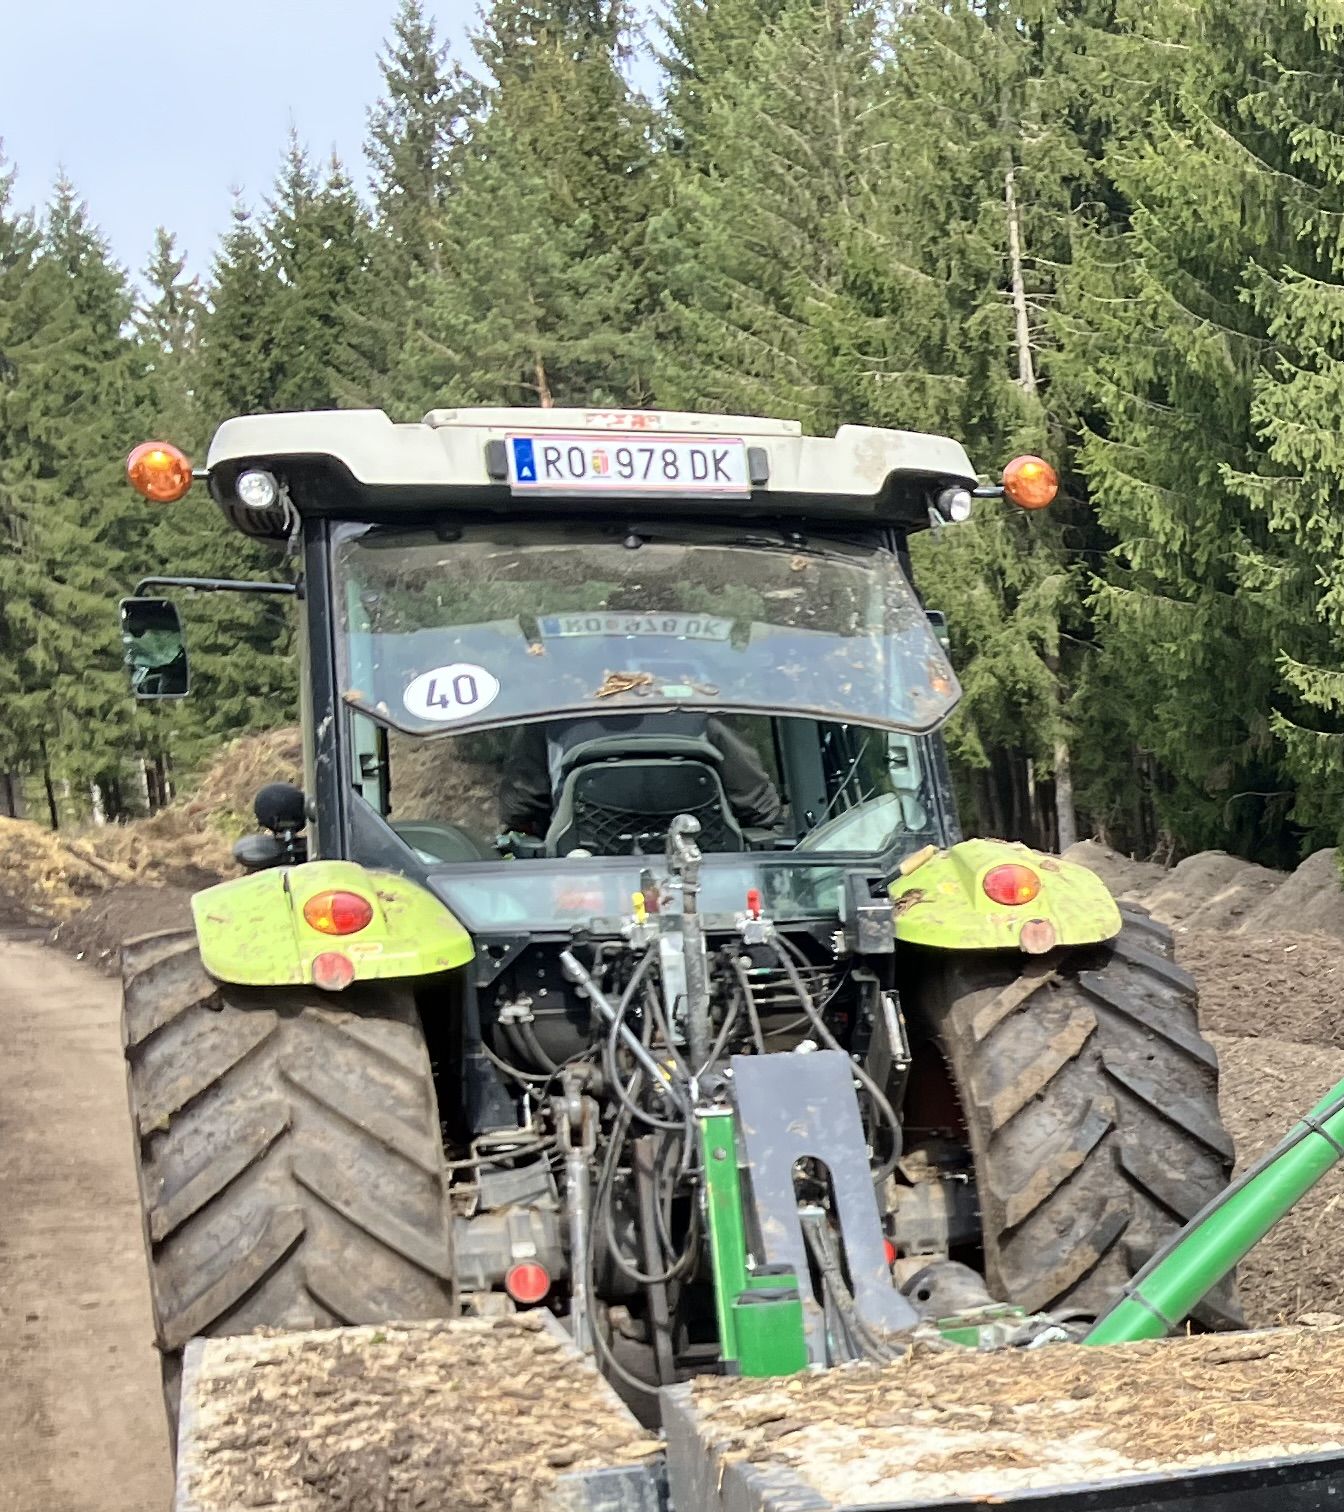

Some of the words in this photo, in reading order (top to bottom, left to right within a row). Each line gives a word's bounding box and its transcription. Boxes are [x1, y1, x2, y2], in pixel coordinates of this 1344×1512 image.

[543, 446, 587, 478] RO
[615, 447, 680, 481] 978
[689, 448, 733, 482] DK
[426, 673, 479, 709] 40
